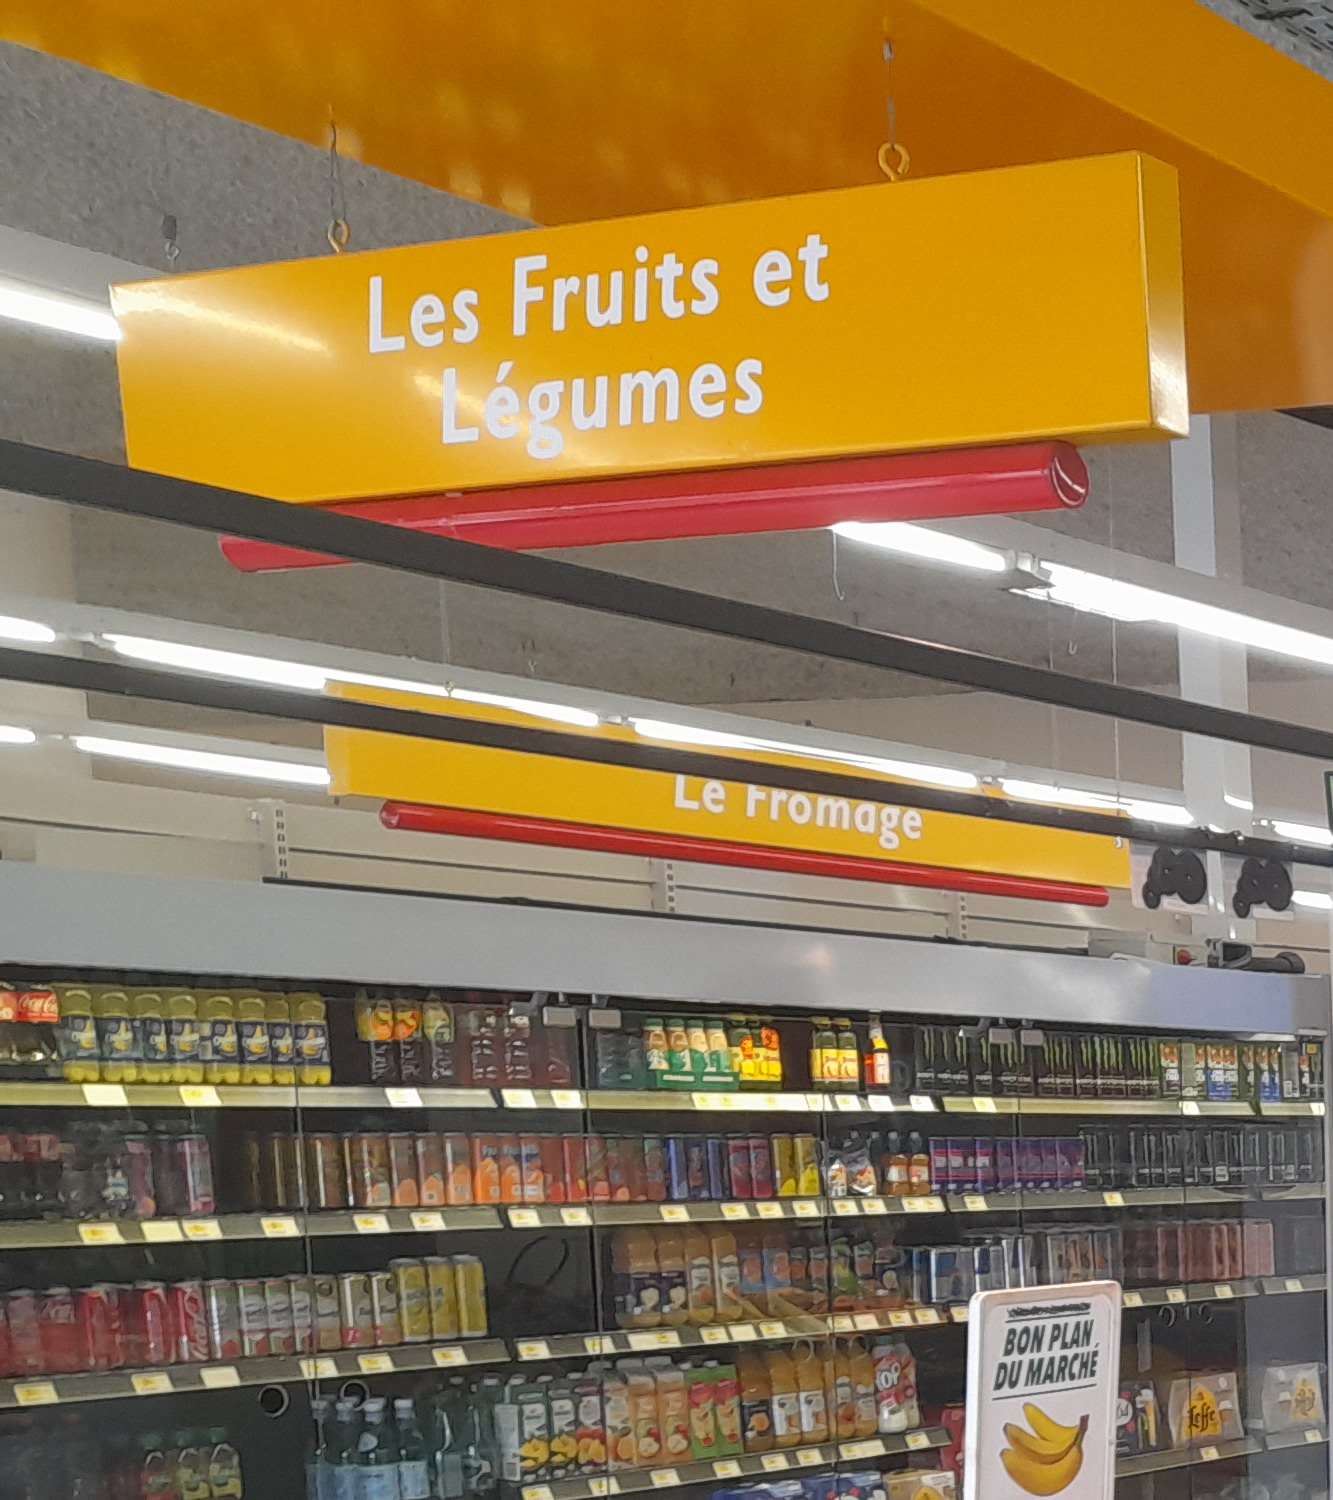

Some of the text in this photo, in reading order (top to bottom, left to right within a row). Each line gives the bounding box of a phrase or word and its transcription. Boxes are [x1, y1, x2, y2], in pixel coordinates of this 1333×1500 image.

[367, 232, 832, 354] Les Fruits et
[439, 357, 765, 459] Légumes
[674, 774, 925, 850] Le Fromage
[994, 1342, 1100, 1391] DU MARCHÉ
[1003, 1319, 1095, 1357] BON PLAN
[1187, 1402, 1216, 1432] Leffe
